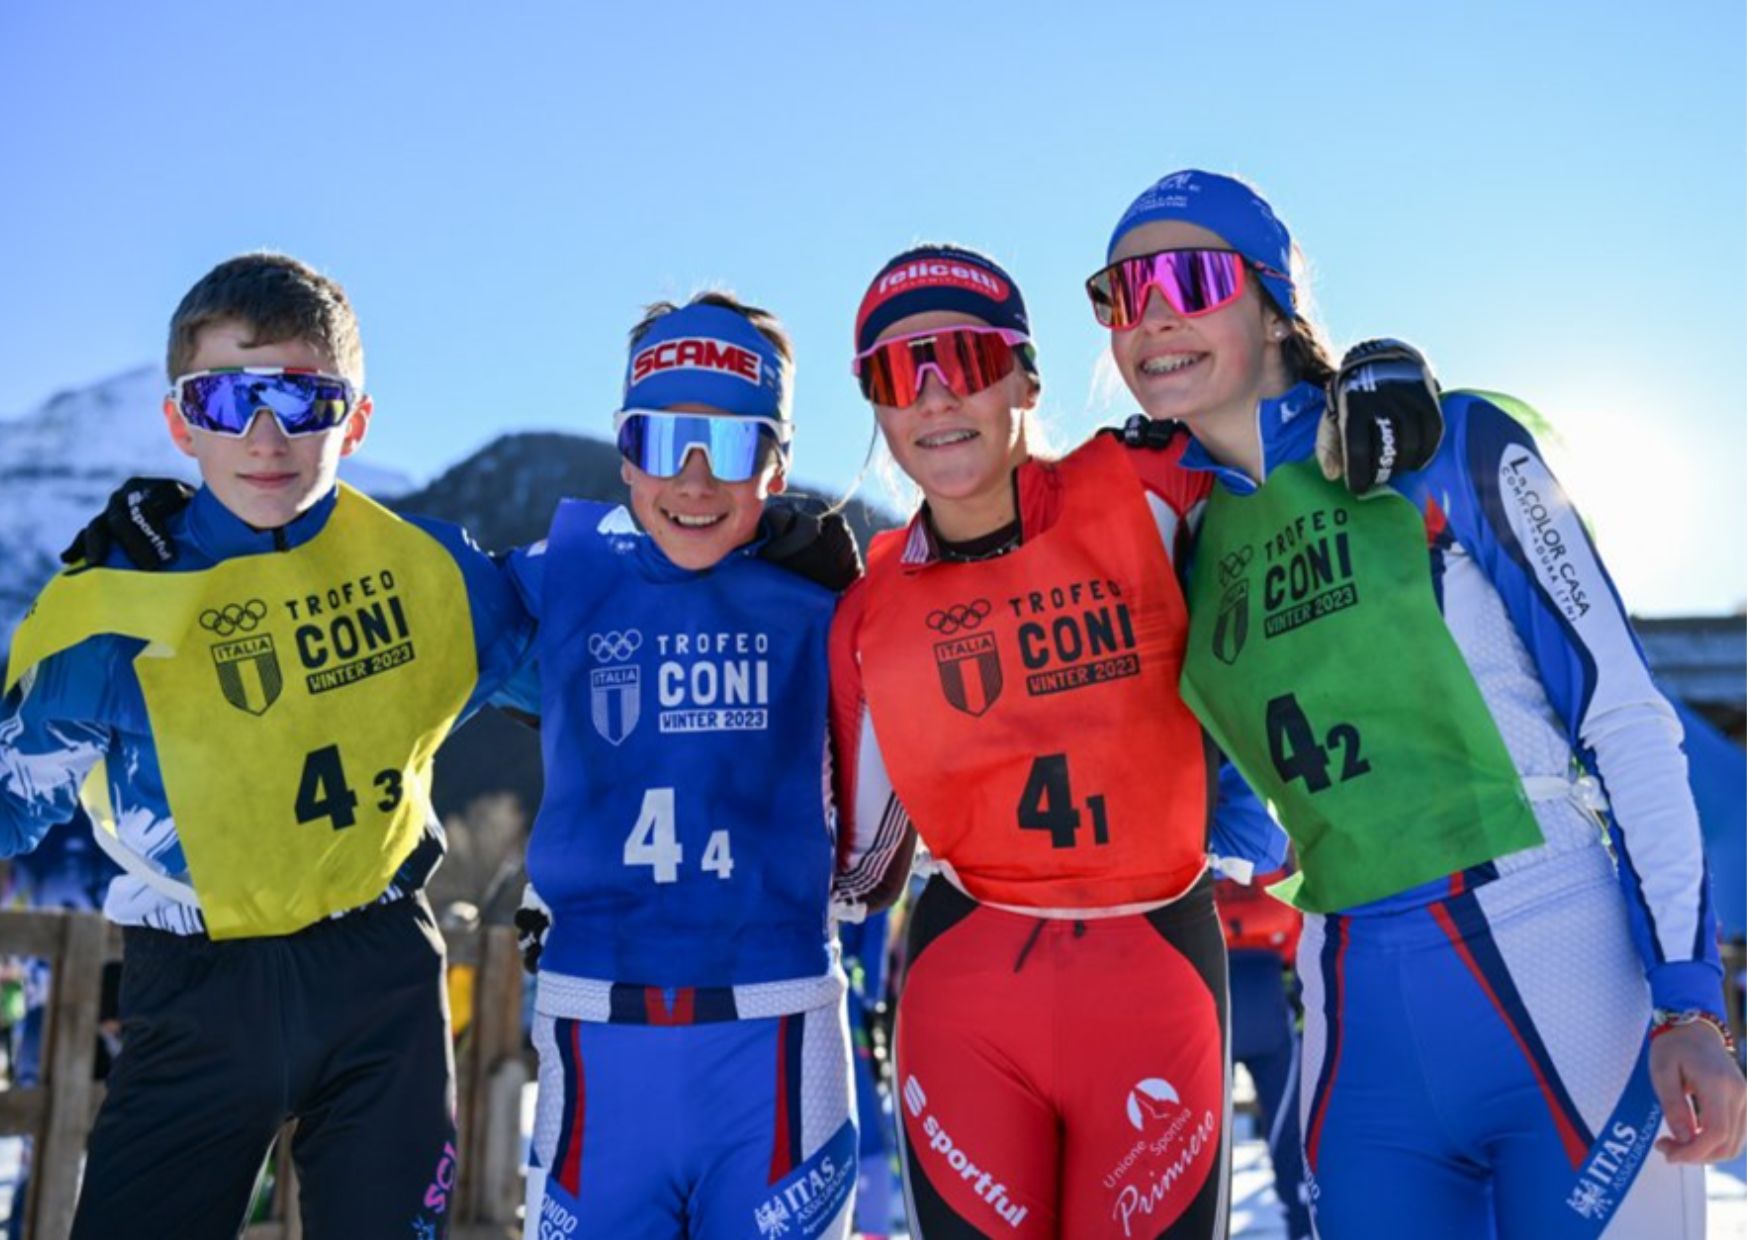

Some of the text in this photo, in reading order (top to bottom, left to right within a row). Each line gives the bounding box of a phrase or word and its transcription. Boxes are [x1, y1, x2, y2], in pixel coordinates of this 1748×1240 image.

[879, 262, 999, 294] felicetti
[633, 340, 758, 382] SCAME
[1264, 508, 1348, 562] TROFEO
[1509, 456, 1591, 618] La COLOR CASA
[285, 569, 395, 620] TROFEO
[1009, 579, 1122, 617] TROFEO
[1264, 532, 1353, 612] CONI
[294, 596, 410, 669] CONI
[1017, 604, 1136, 669] CONI
[1266, 586, 1354, 635] WINTER 2023
[217, 639, 272, 659] ITALIA
[309, 645, 412, 691] WINTER 2023
[657, 633, 768, 655] TROFEO
[939, 638, 994, 658] ITALIA
[595, 670, 637, 685] ITALIA
[658, 660, 768, 707] CONI
[1029, 656, 1138, 692] WINTER 2023
[662, 710, 765, 729] WINTER 2023
[1265, 692, 1372, 794] 4 2
[294, 743, 403, 831] 4 3
[1016, 753, 1109, 848] 4 1
[623, 787, 734, 883] 4 4
[923, 1115, 1029, 1229] sportful
[1103, 1107, 1192, 1189] Unione Sportiva
[1112, 1109, 1215, 1237] Primiero
[1587, 1121, 1637, 1185] ITAS
[784, 1155, 836, 1213] ITAS
